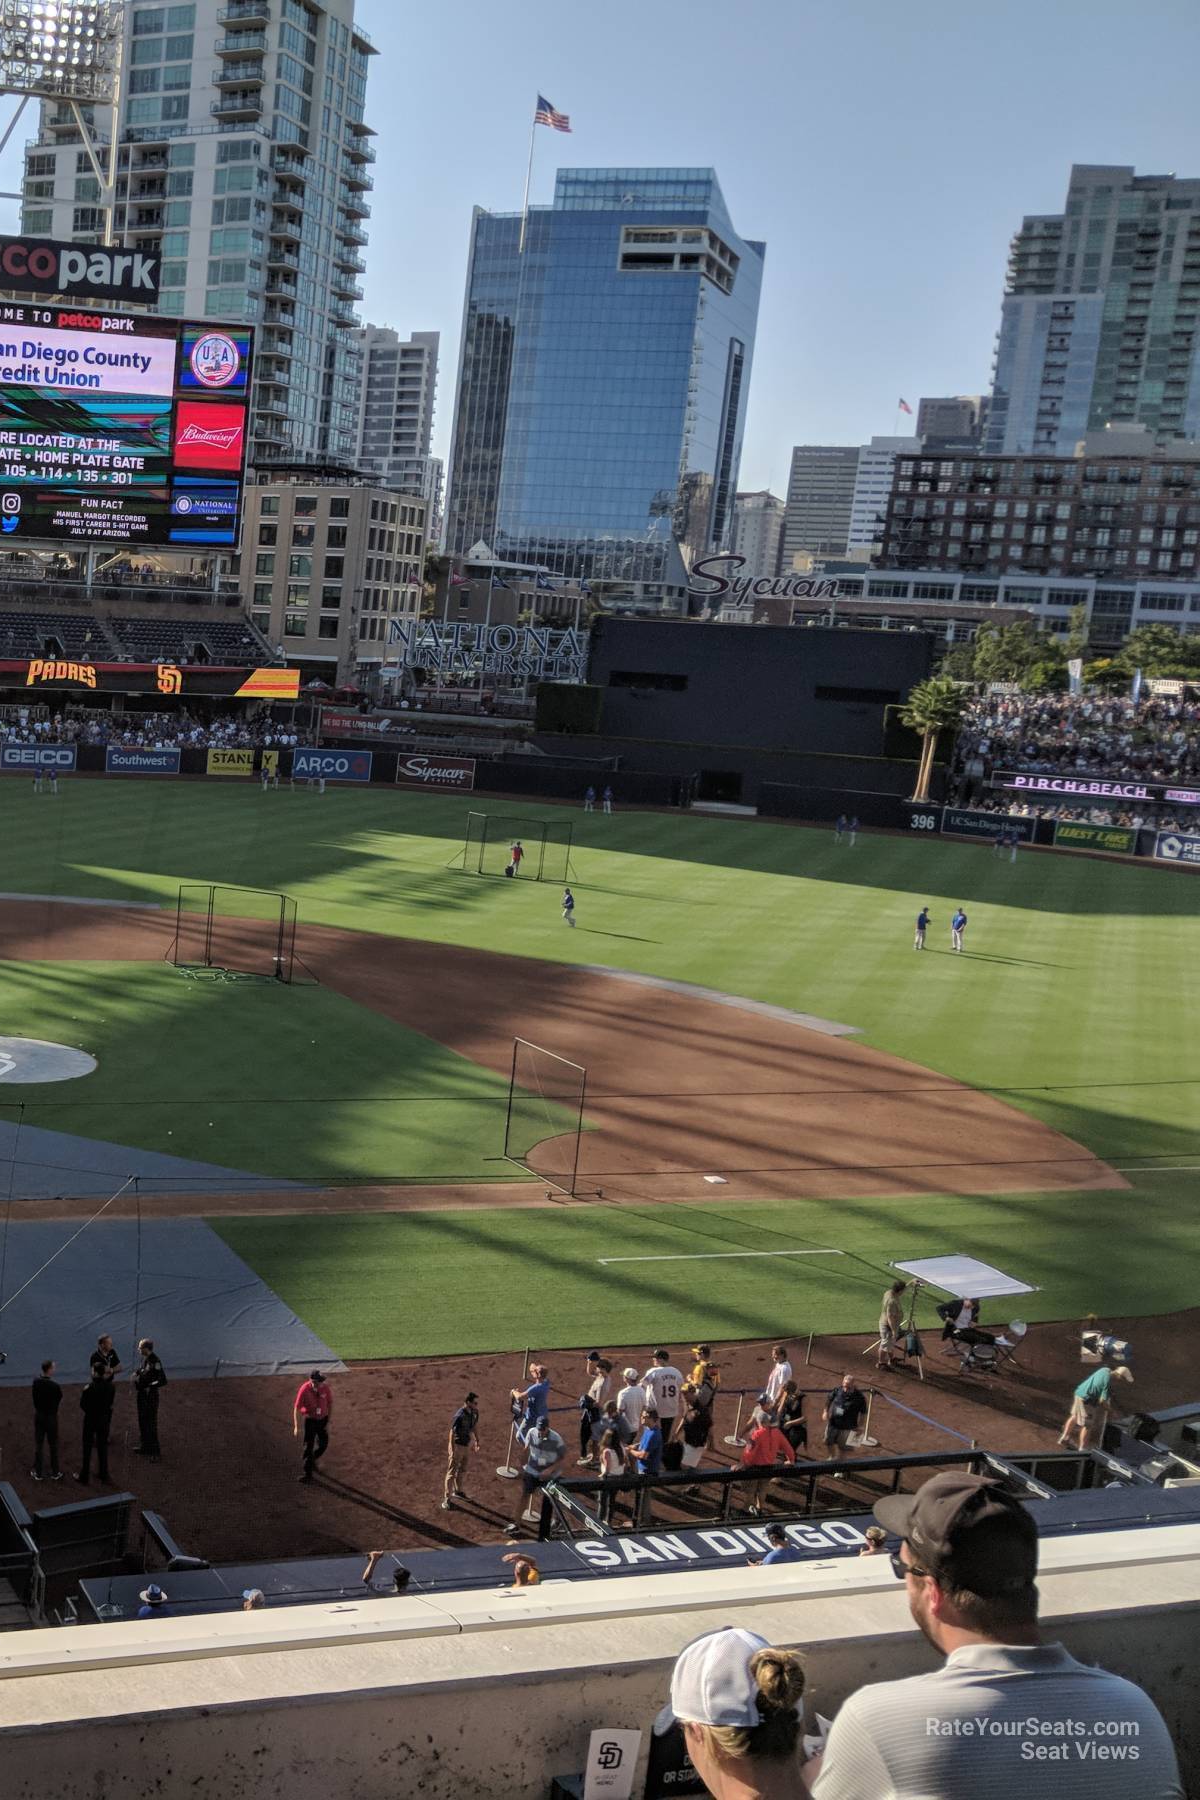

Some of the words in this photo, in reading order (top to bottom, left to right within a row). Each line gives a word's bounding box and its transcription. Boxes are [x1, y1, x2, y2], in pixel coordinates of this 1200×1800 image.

[33, 311, 51, 323] TO
[21, 341, 79, 367] Diego
[82, 346, 152, 374] County
[19, 432, 75, 449] LOCATED
[77, 437, 95, 450] AT
[96, 438, 121, 452] THE
[185, 428, 234, 442] Budweiser
[34, 451, 69, 464] HOME
[72, 453, 110, 468] PLATE
[113, 455, 145, 470] GATE
[4, 463, 27, 477] 105
[40, 467, 63, 479] 114
[77, 469, 99, 483] 135
[111, 472, 133, 485] 301
[81, 498, 100, 509] FUN
[100, 500, 124, 510] FACT
[194, 500, 233, 509] NATIONAL
[56, 510, 82, 519] MANUEL
[84, 512, 110, 521] MARGOT
[112, 514, 146, 523] RECORDED
[65, 519, 84, 527] FIRST
[85, 520, 111, 528] CAREER
[130, 523, 149, 531] GAME
[70, 527, 86, 535] JULY
[103, 529, 131, 538] ARIZONA
[686, 555, 843, 608] Sycuan
[386, 619, 585, 657] NATIONA
[26, 659, 97, 689] PADRES
[402, 648, 587, 683] UNIVERSITY
[3, 749, 73, 765] GEICO
[111, 752, 168, 767] Southwest
[212, 752, 272, 765] STANLY
[295, 756, 349, 773] ARCO
[406, 758, 465, 782] Sycuan
[911, 813, 935, 830] 396
[1057, 827, 1096, 840] WEST
[1096, 831, 1131, 844] LAKE
[661, 1384, 676, 1398] 19
[574, 1536, 691, 1567] SAN
[663, 1771, 677, 1783] OR
